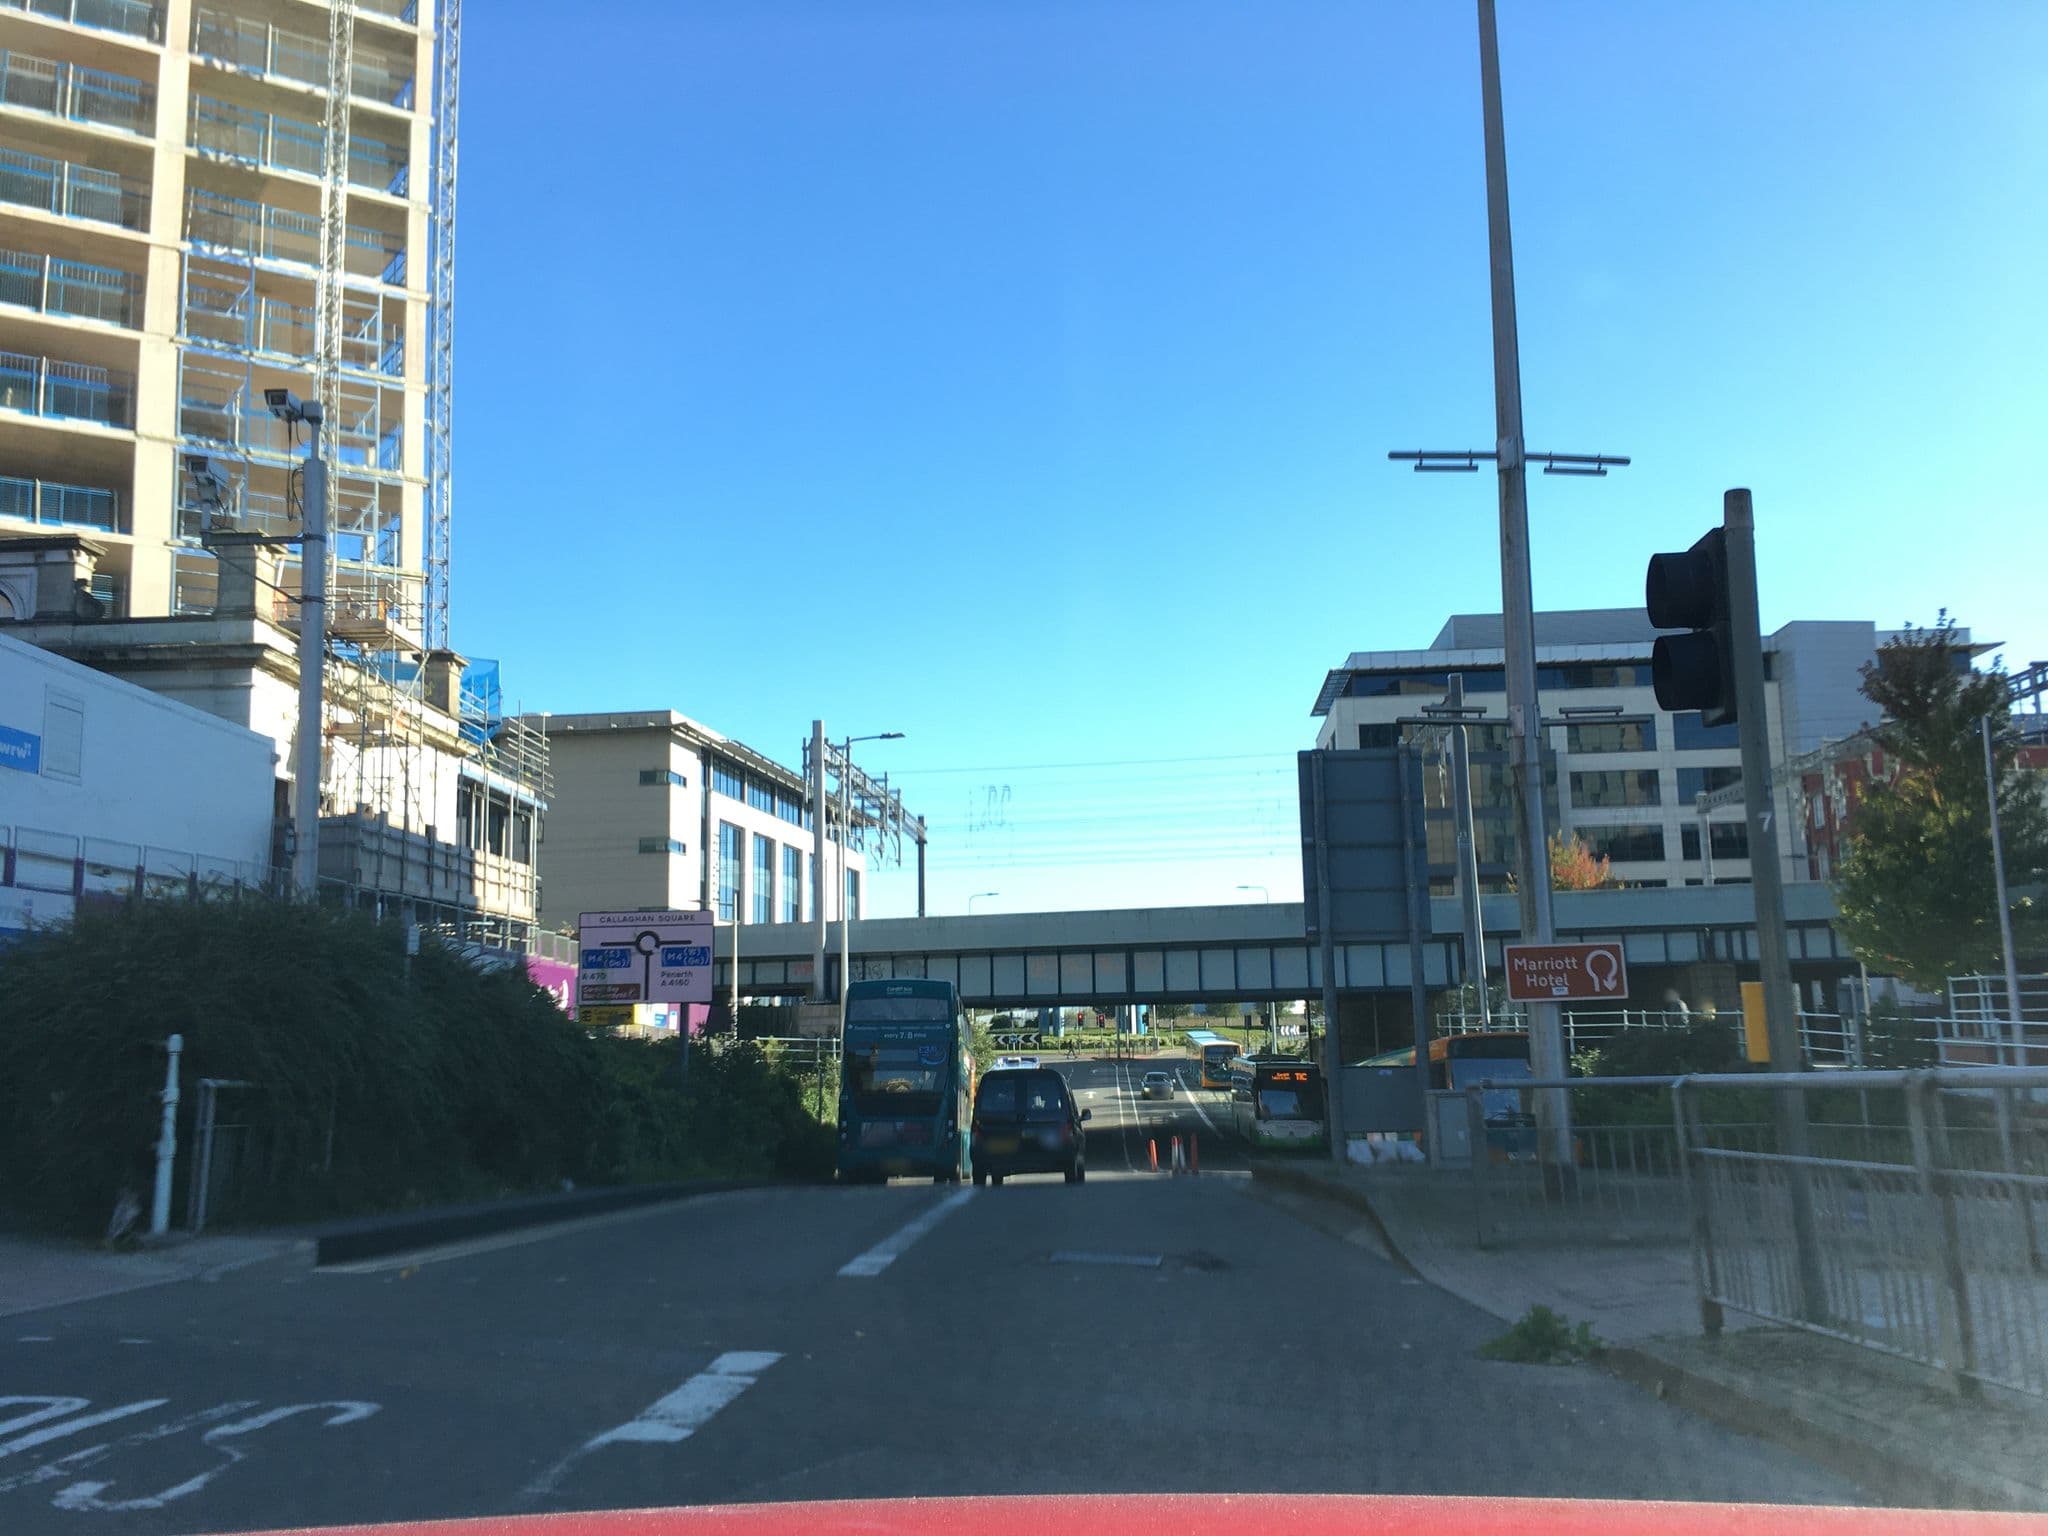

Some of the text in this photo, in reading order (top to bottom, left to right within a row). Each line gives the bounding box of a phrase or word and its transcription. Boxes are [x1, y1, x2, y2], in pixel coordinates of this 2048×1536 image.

[1757, 811, 1773, 832] 7
[600, 913, 696, 924] CALLAGHAN SQUARE
[1514, 956, 1579, 972] Marriott
[1525, 972, 1570, 987] Hotel
